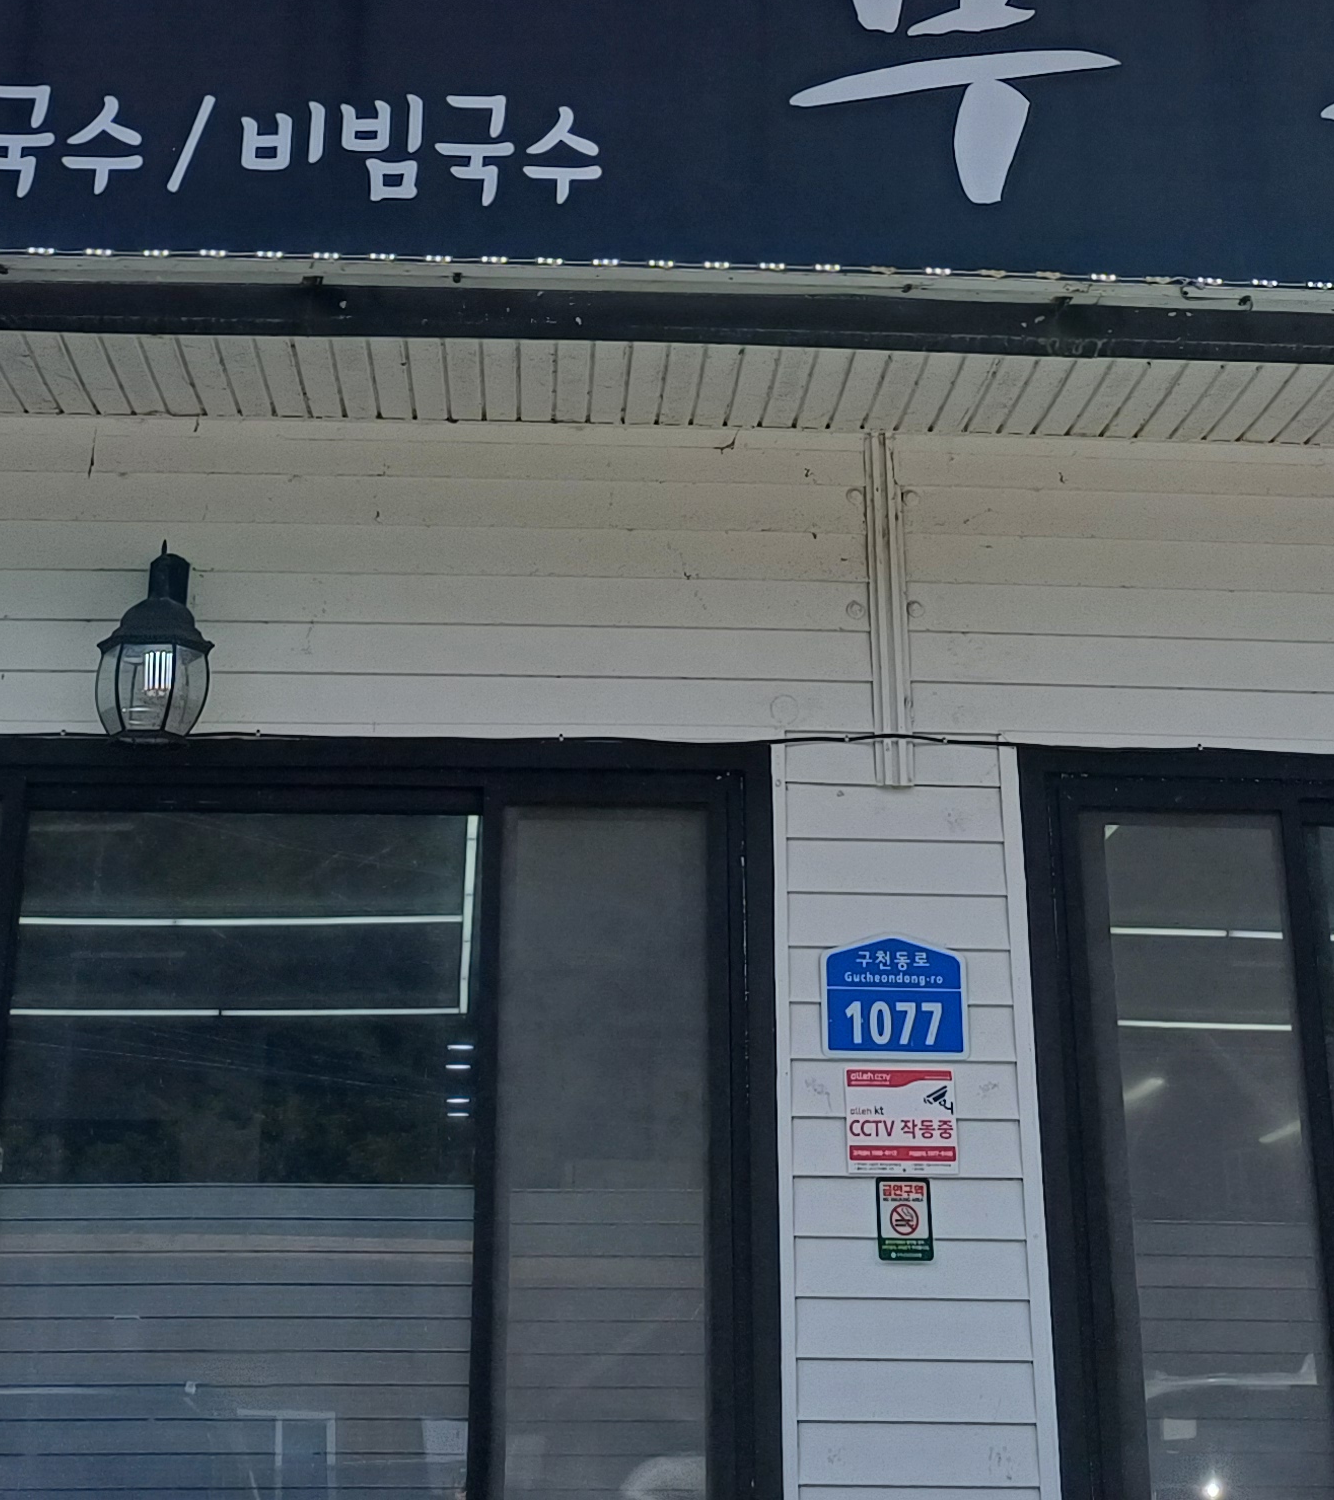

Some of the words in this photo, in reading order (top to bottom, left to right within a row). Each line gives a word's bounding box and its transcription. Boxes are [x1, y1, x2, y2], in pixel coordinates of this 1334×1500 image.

[855, 950, 930, 971] 구천동로
[844, 972, 943, 986] Gucheondong-ro
[845, 1001, 942, 1045] 1077
[874, 1106, 885, 1116] kt
[849, 1119, 895, 1137] CCTV
[900, 1119, 954, 1140] 작동중
[883, 1184, 925, 1197] 금연구역
